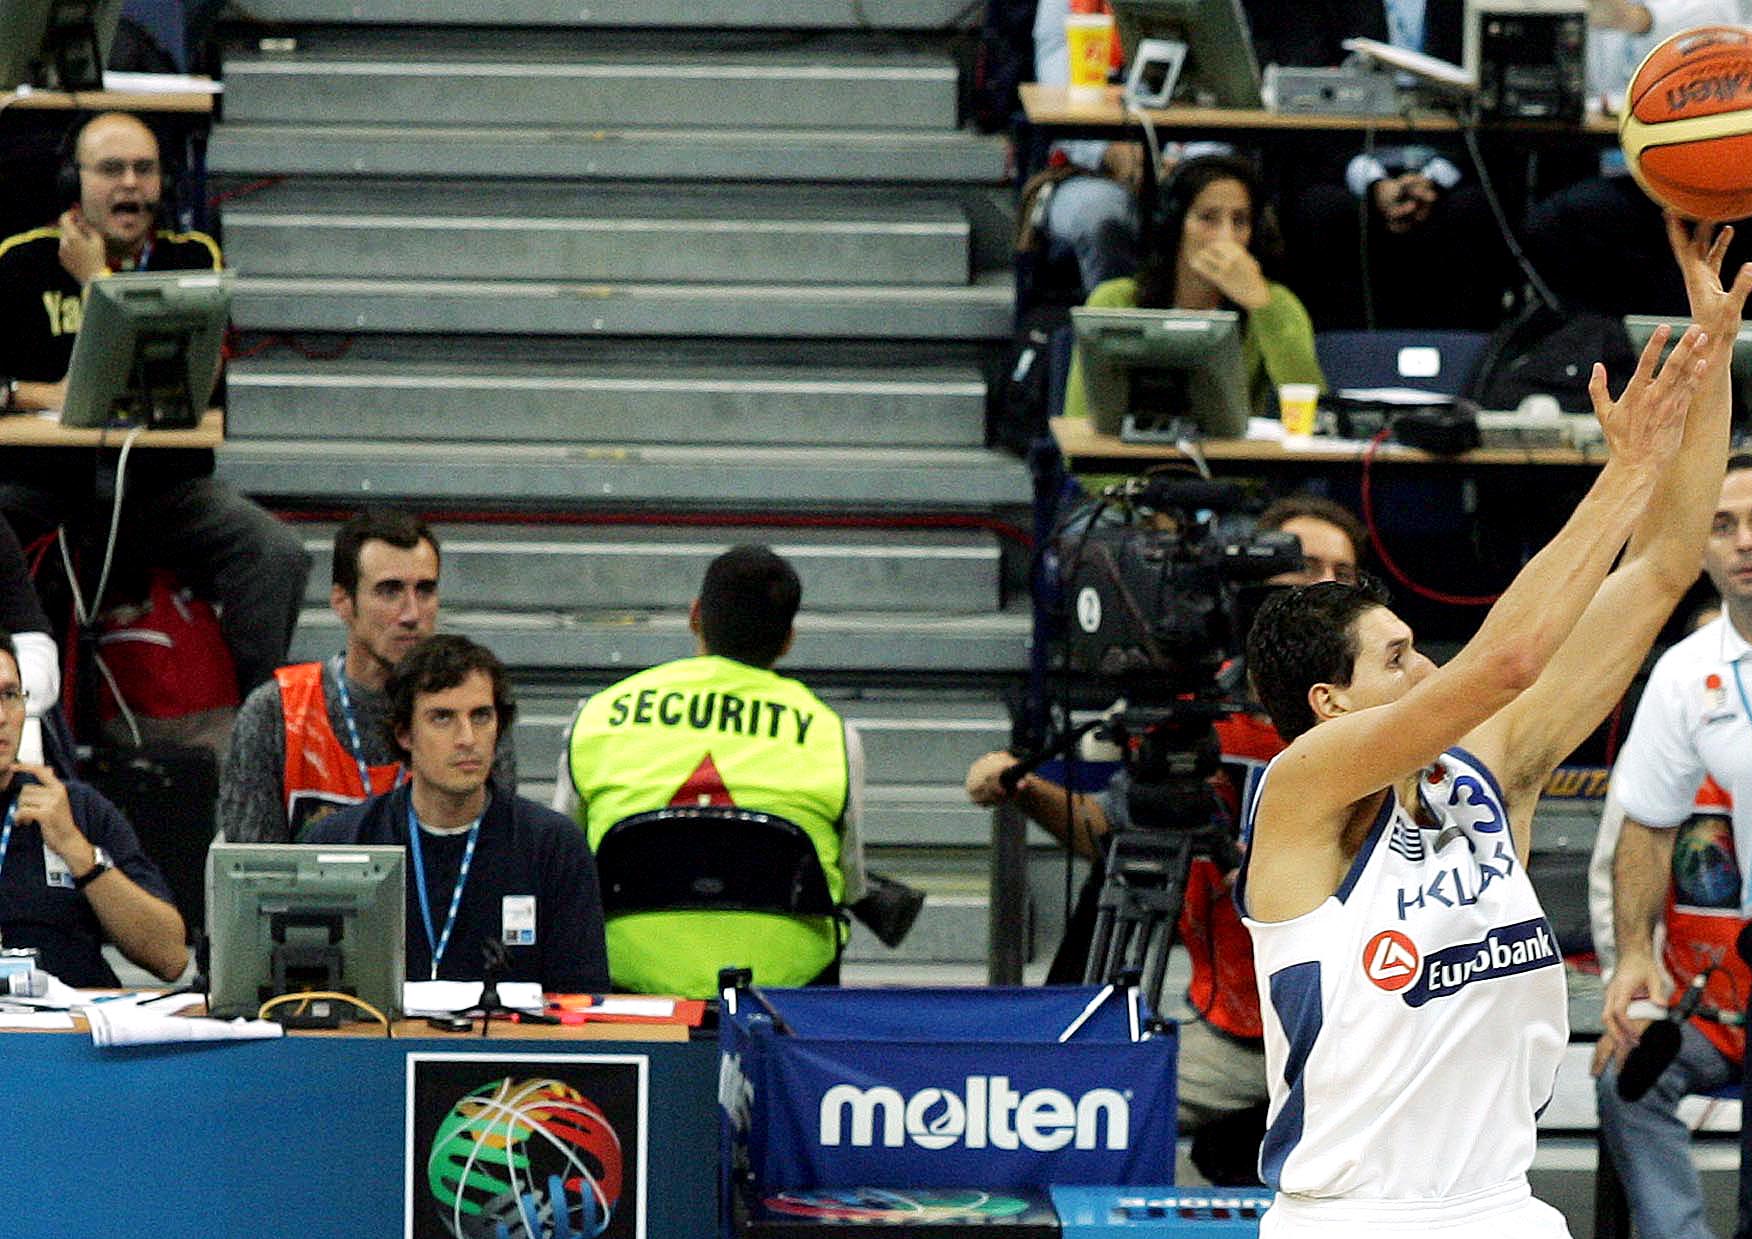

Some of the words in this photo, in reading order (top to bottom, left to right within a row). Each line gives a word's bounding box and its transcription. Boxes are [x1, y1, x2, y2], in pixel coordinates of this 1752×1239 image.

[43, 291, 89, 336] Ya
[608, 690, 813, 744] SECURITY
[1448, 776, 1503, 834] 3
[1397, 841, 1514, 920] HELAS
[1428, 927, 1553, 991] Eurobank
[819, 1075, 1130, 1151] molten
